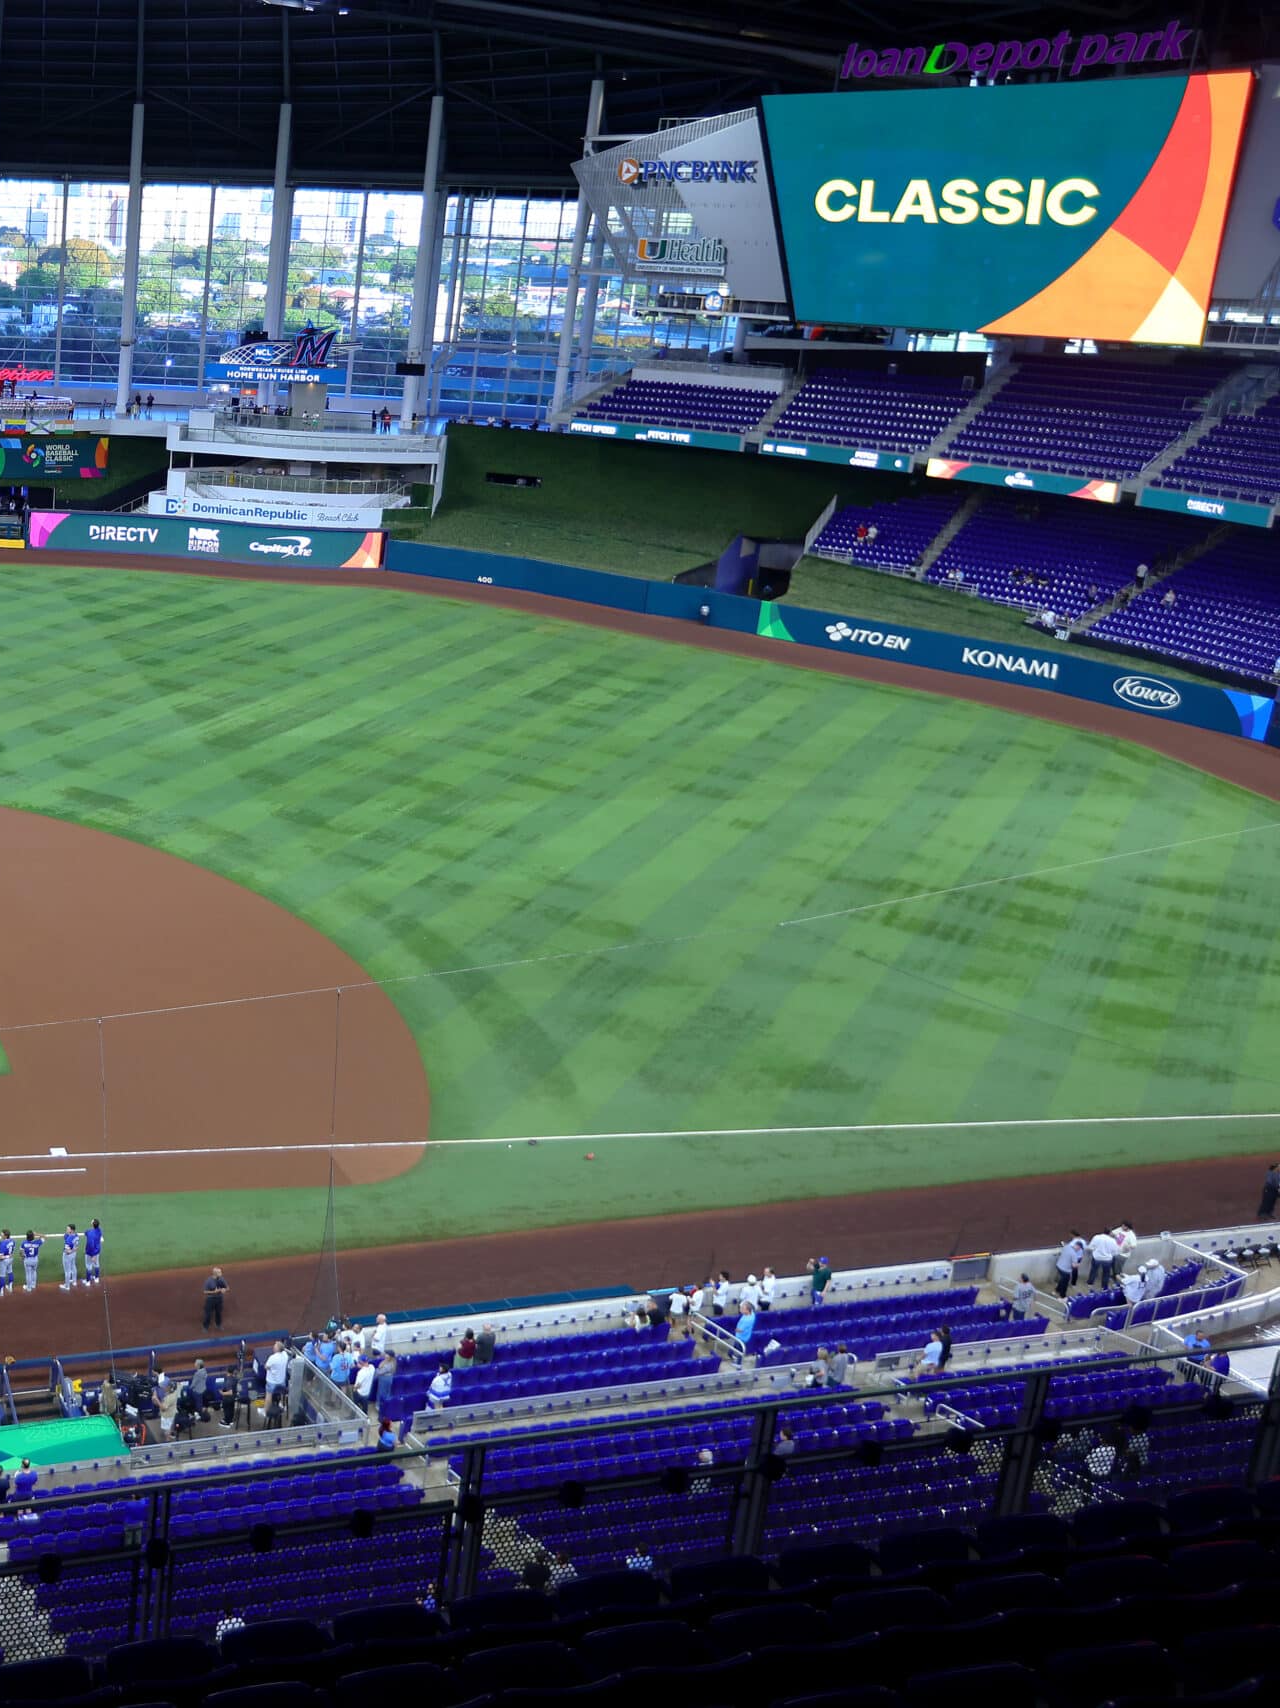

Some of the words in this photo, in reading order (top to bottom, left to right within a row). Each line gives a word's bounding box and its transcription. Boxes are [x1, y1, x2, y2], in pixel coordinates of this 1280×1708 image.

[840, 30, 1072, 79] loanDepot
[1071, 20, 1193, 76] park
[815, 179, 1099, 226] CLASSIC
[255, 348, 271, 356] NCL
[227, 371, 254, 380] HOME
[257, 372, 277, 381] RUN
[280, 373, 320, 382] HARBOR
[1186, 499, 1225, 515] DIRECTV
[89, 525, 159, 543] DIRECTV
[188, 539, 220, 548] NIPPON
[477, 575, 493, 584] 400
[850, 628, 883, 646] ITO
[883, 634, 911, 651] EN
[962, 647, 1058, 680] KONAMI
[1118, 678, 1178, 705] Kowa
